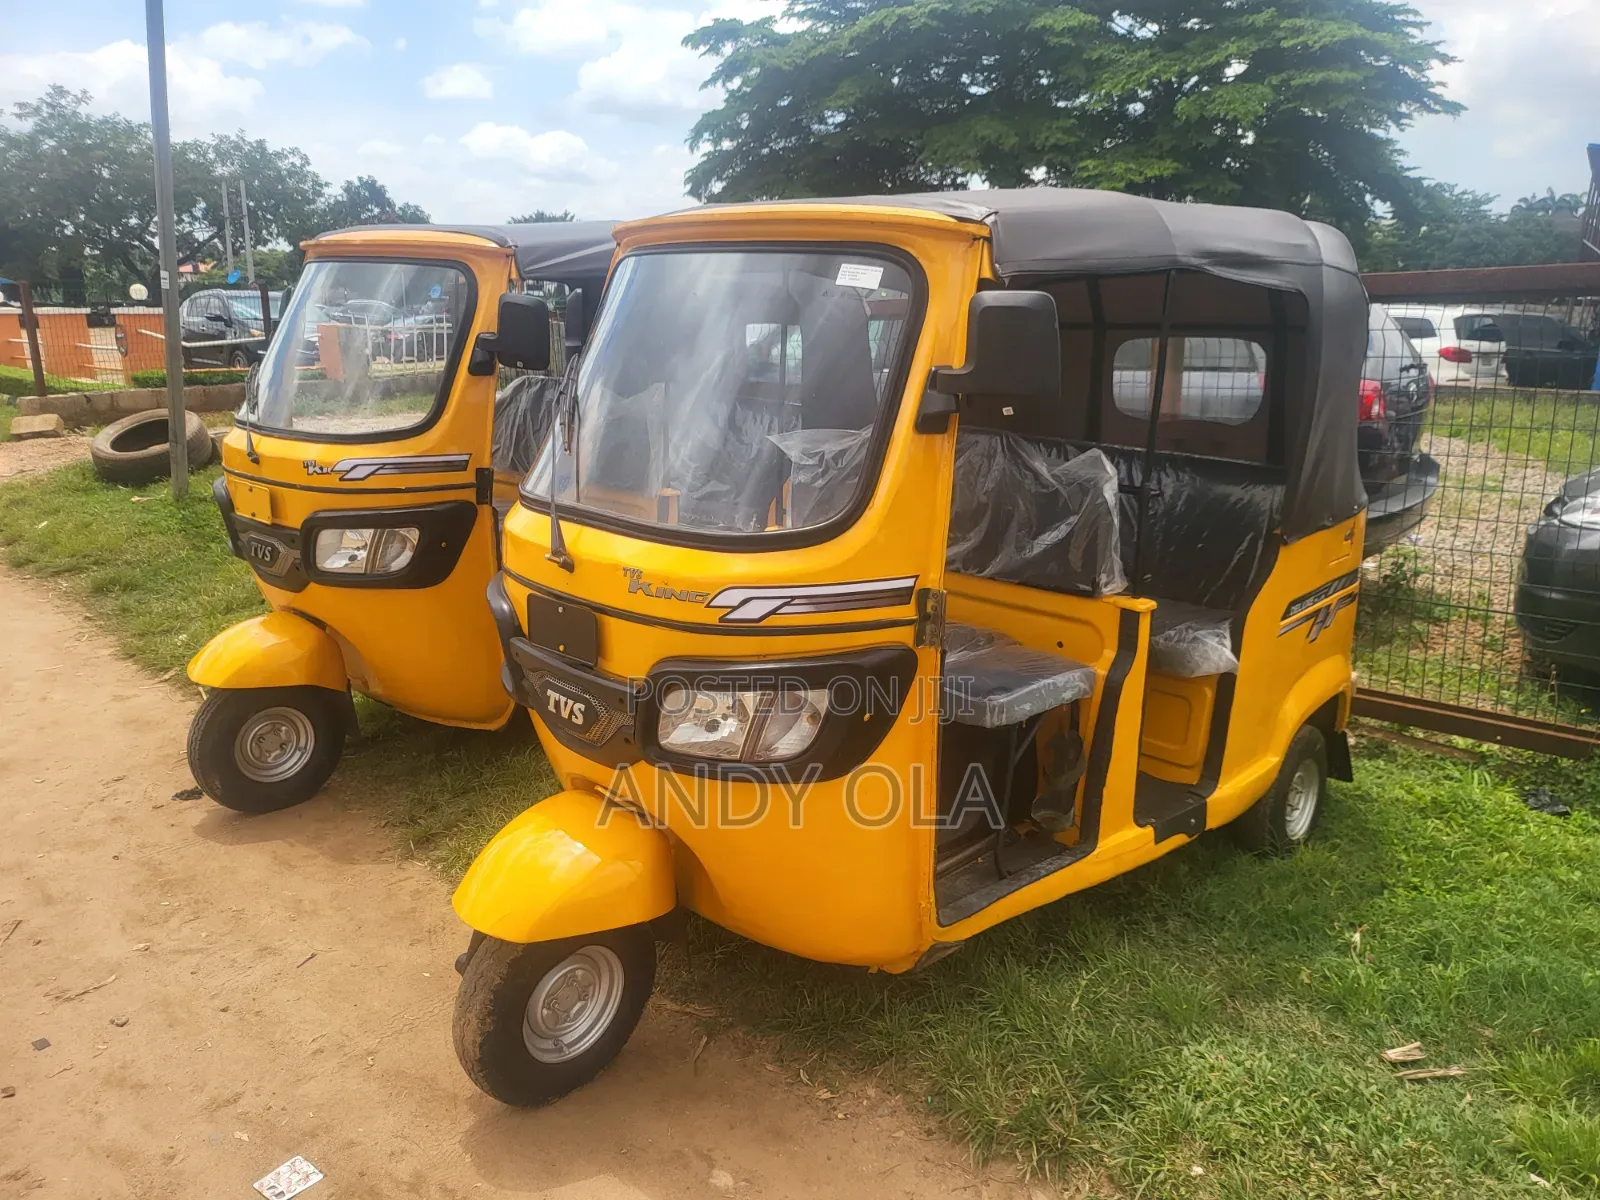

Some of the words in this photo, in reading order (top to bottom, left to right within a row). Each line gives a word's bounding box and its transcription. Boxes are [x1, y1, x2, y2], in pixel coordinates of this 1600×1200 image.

[250, 541, 272, 562] TVS
[622, 566, 643, 579] TVS
[546, 688, 586, 725] TVS
